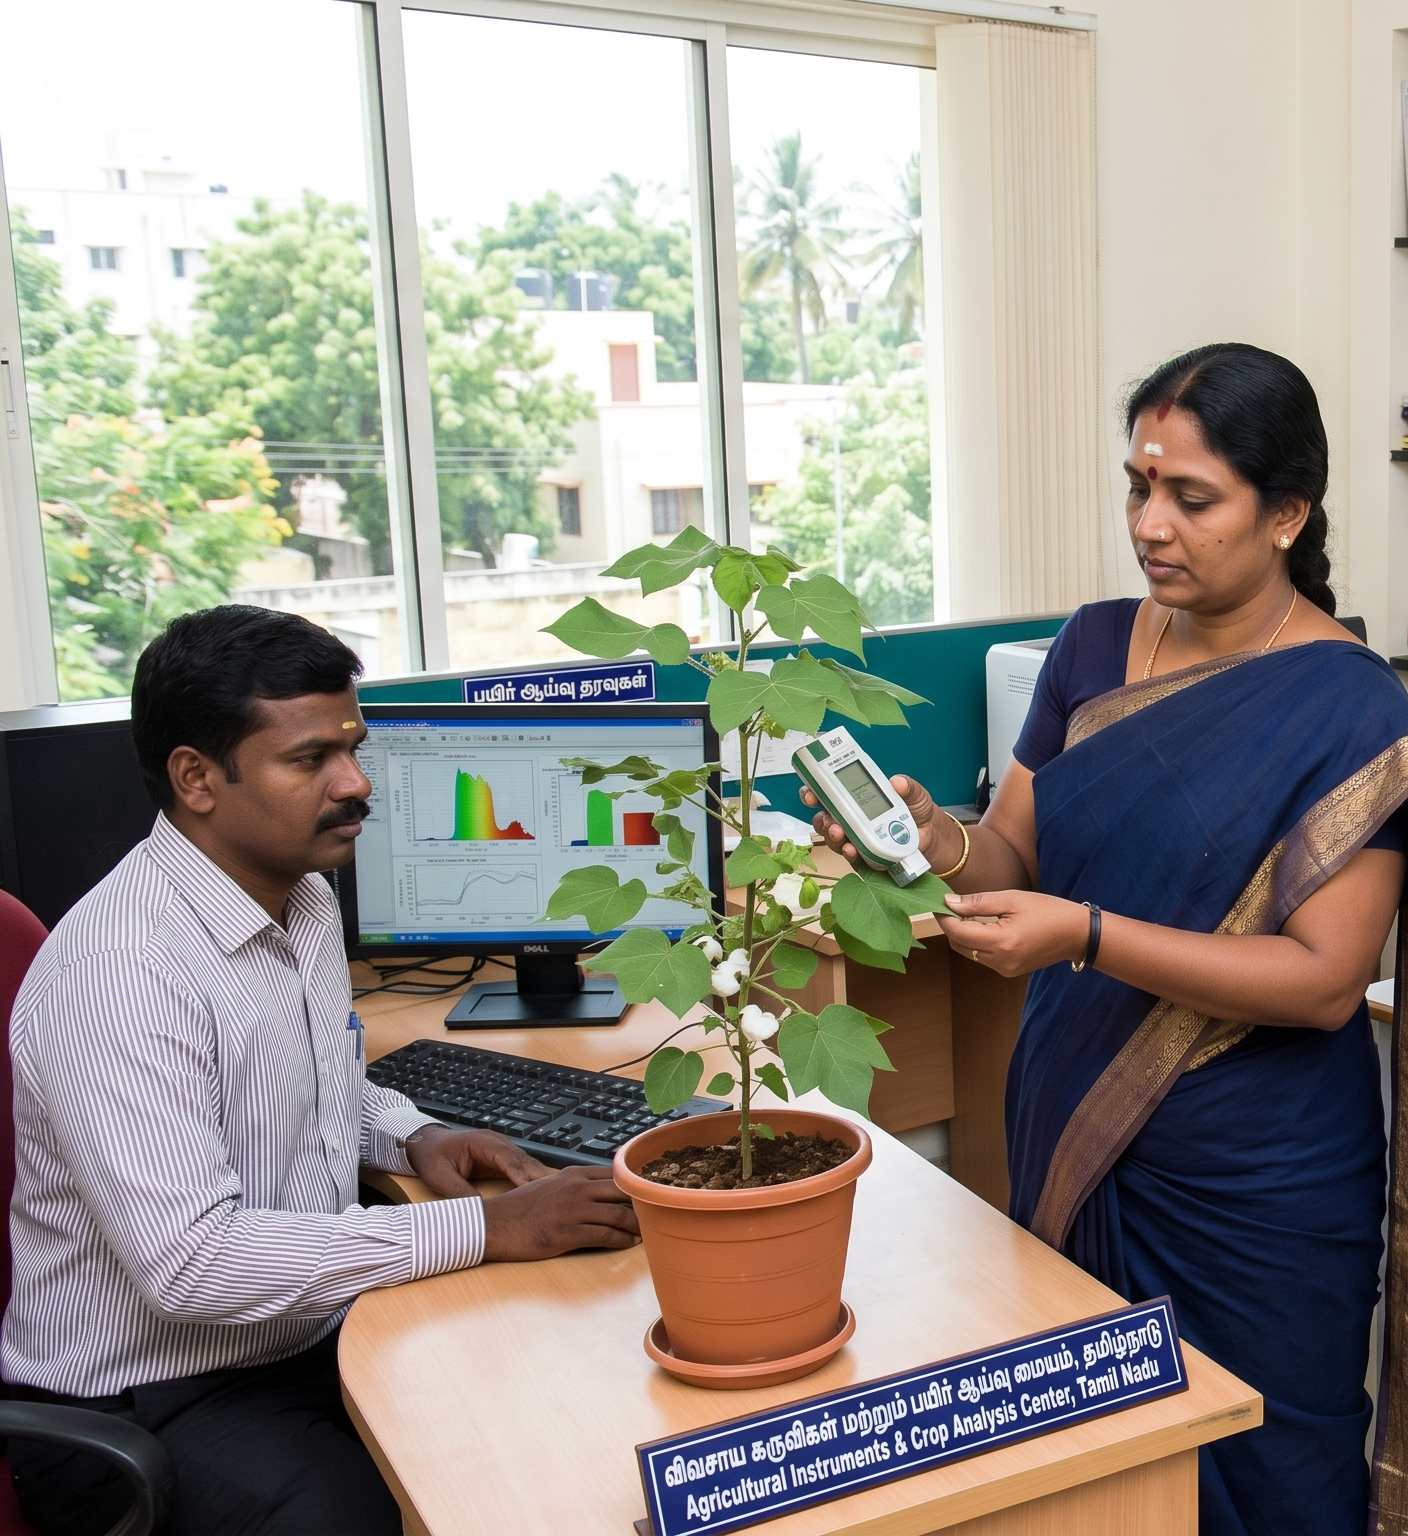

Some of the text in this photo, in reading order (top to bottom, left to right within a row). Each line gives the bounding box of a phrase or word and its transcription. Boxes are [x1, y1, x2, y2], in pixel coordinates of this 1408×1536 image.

[473, 669, 648, 703] பயிர் ஆய்வு தரவுகள்
[523, 945, 550, 953] DELL
[664, 1318, 1163, 1488] விவசாய கருவிகள் மற்றும் பயிர் ஆய்வு மையம், தமிழ்நாடு
[687, 1356, 1160, 1522] Agricultural Instruments & Crop Analysis Center, Tamil Nadu
